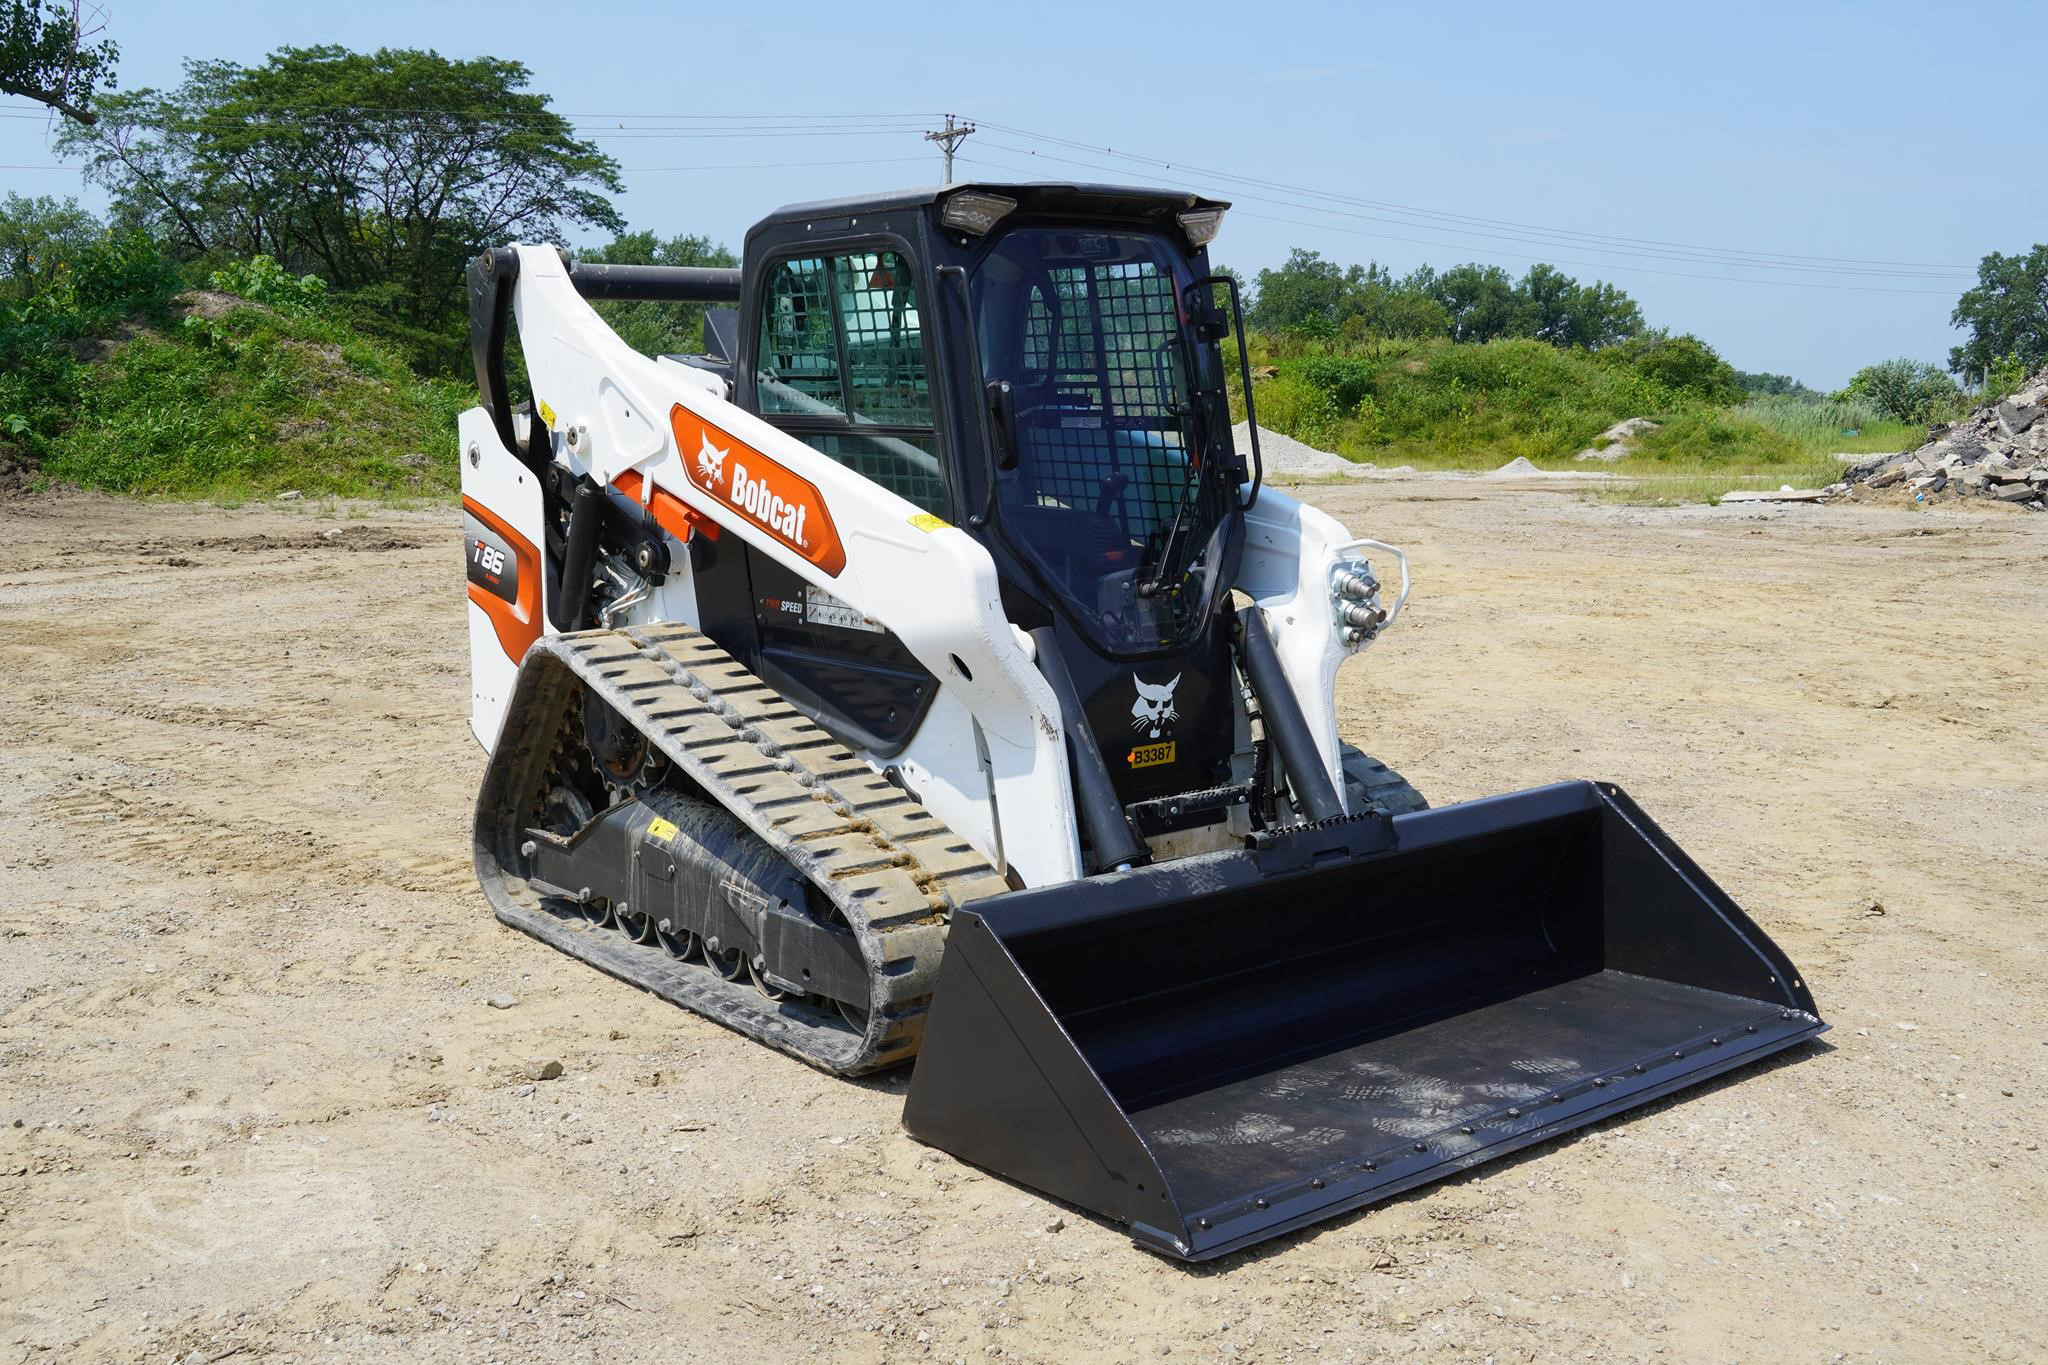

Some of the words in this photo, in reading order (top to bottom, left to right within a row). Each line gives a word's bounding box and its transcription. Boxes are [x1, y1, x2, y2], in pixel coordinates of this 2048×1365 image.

[731, 462, 806, 547] Bobcat
[474, 540, 505, 575] T86
[781, 600, 803, 614] SPEED
[1134, 745, 1173, 765] B3387
